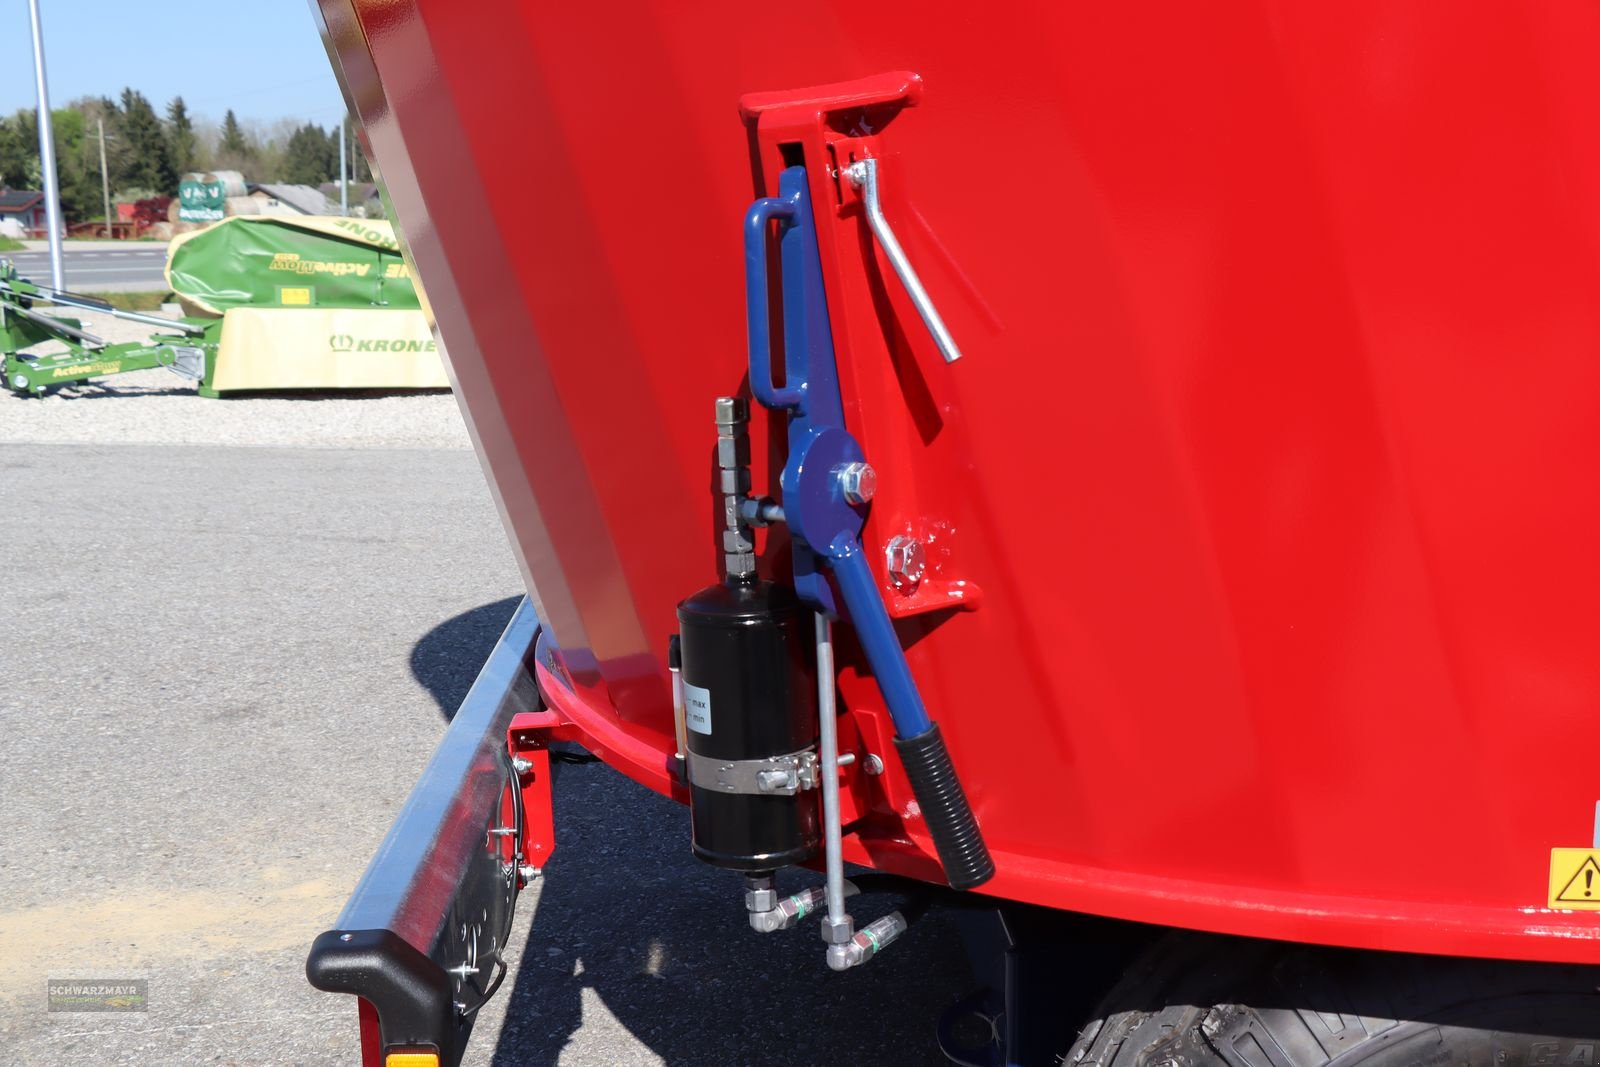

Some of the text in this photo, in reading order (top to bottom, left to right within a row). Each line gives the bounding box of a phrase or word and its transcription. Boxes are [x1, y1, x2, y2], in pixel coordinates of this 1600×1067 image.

[356, 339, 437, 352] KRONE
[692, 699, 706, 709] max
[693, 714, 705, 723] min
